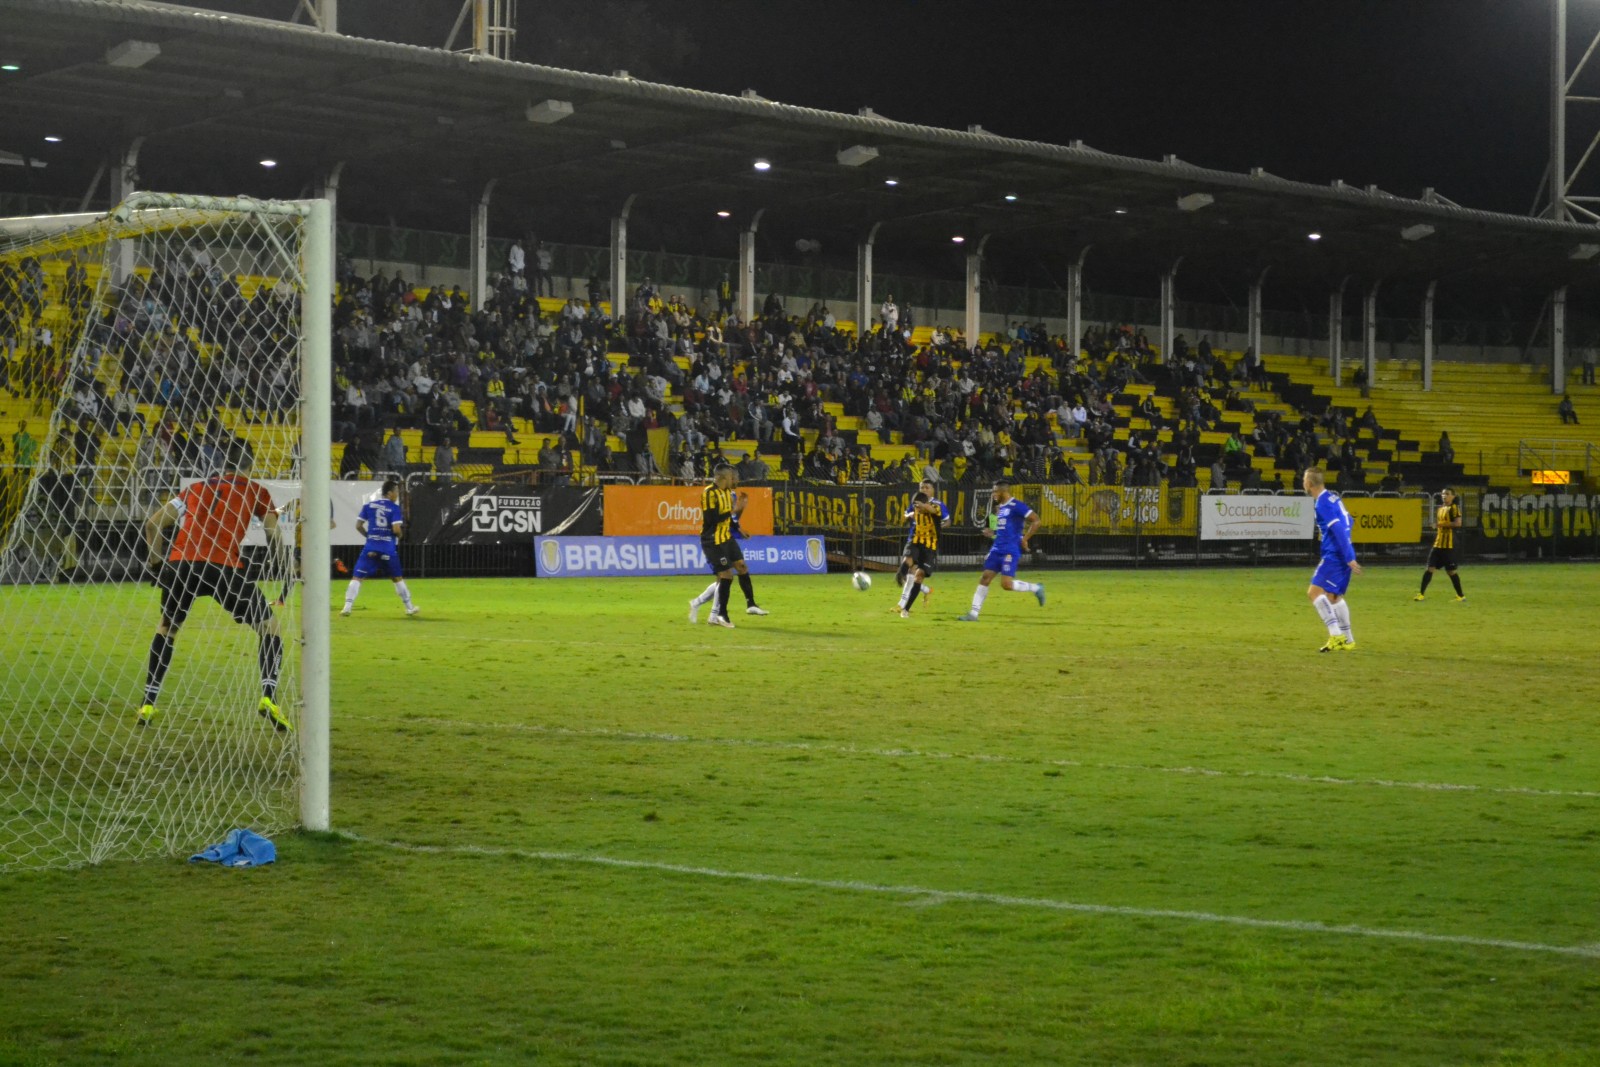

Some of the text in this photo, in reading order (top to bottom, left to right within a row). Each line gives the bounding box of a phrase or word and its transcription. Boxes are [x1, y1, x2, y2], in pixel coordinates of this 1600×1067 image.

[498, 499, 541, 507] FUNDAÇÃO
[375, 509, 388, 528] 6
[498, 509, 541, 532] CSN
[657, 500, 703, 525] Orthop
[1360, 514, 1394, 529] GLOBUS
[741, 548, 765, 561] ÉRIE
[766, 547, 779, 563] D
[780, 549, 804, 561] 2016
